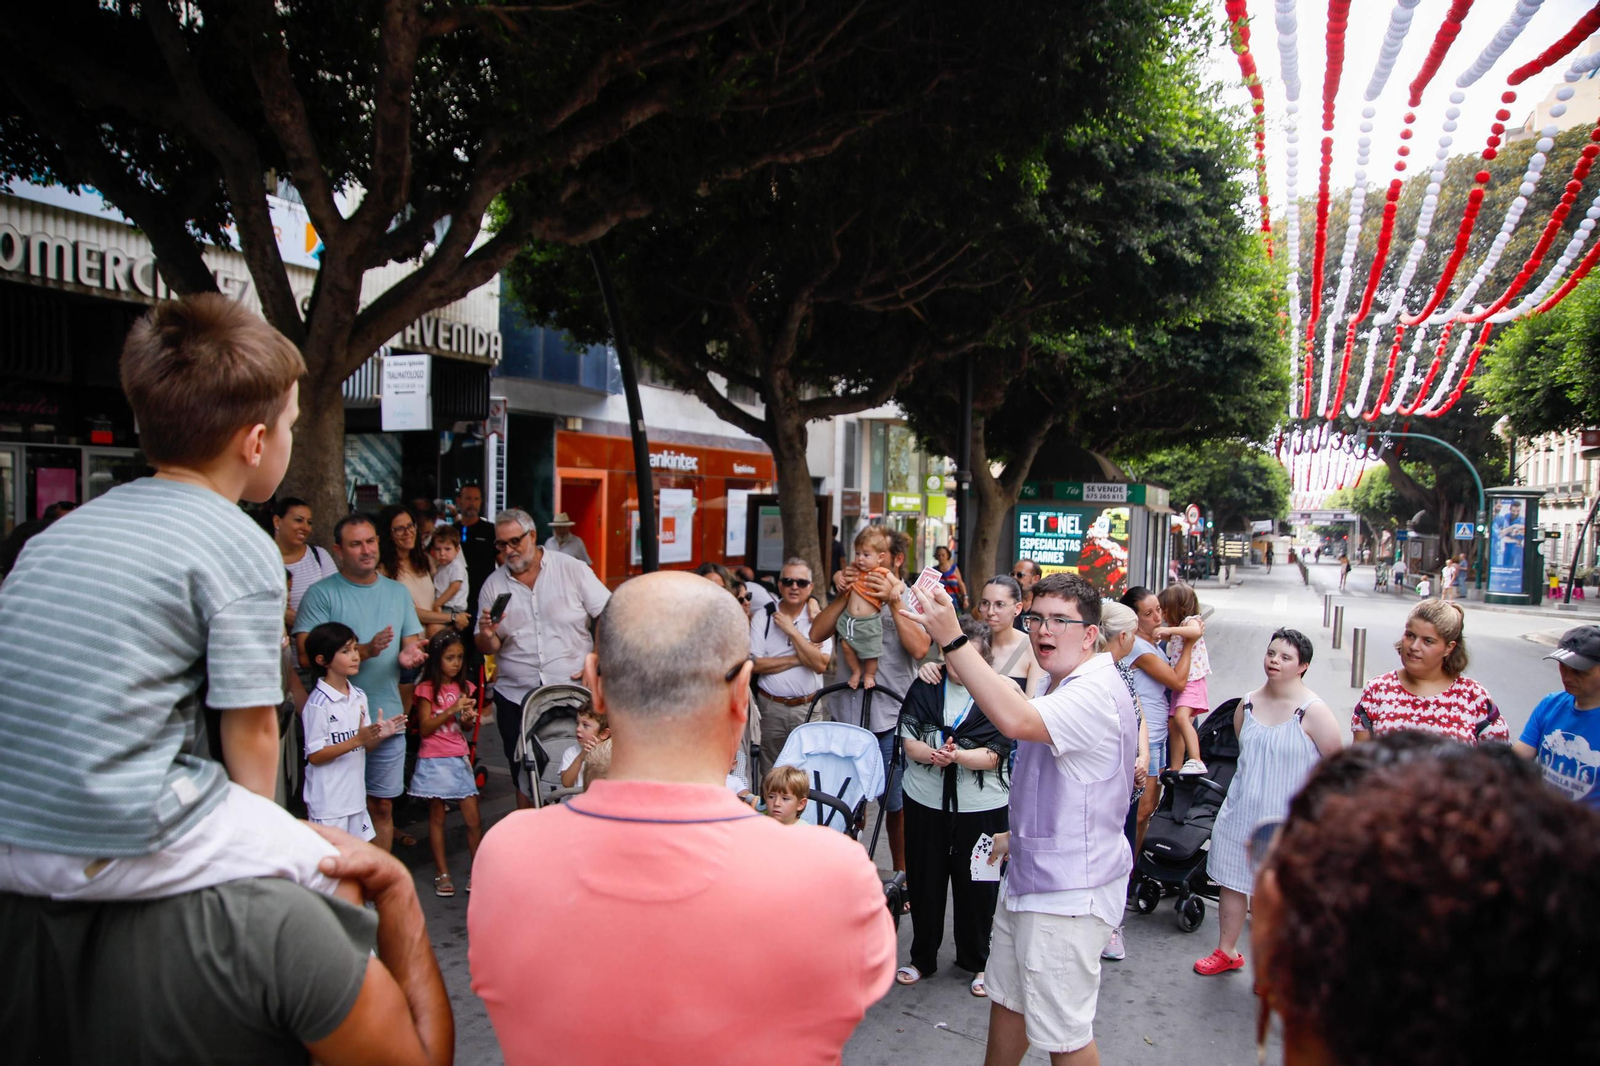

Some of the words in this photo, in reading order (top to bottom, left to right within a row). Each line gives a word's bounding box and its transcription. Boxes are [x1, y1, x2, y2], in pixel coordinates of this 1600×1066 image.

[405, 315, 502, 360] AVENIDA
[1086, 485, 1096, 493] SE
[1097, 485, 1124, 494] VENDE
[1019, 514, 1035, 532] EL
[1019, 538, 1080, 552] ESPECIALISTAS
[1019, 550, 1031, 562] EN
[1032, 551, 1065, 564] CARNES
